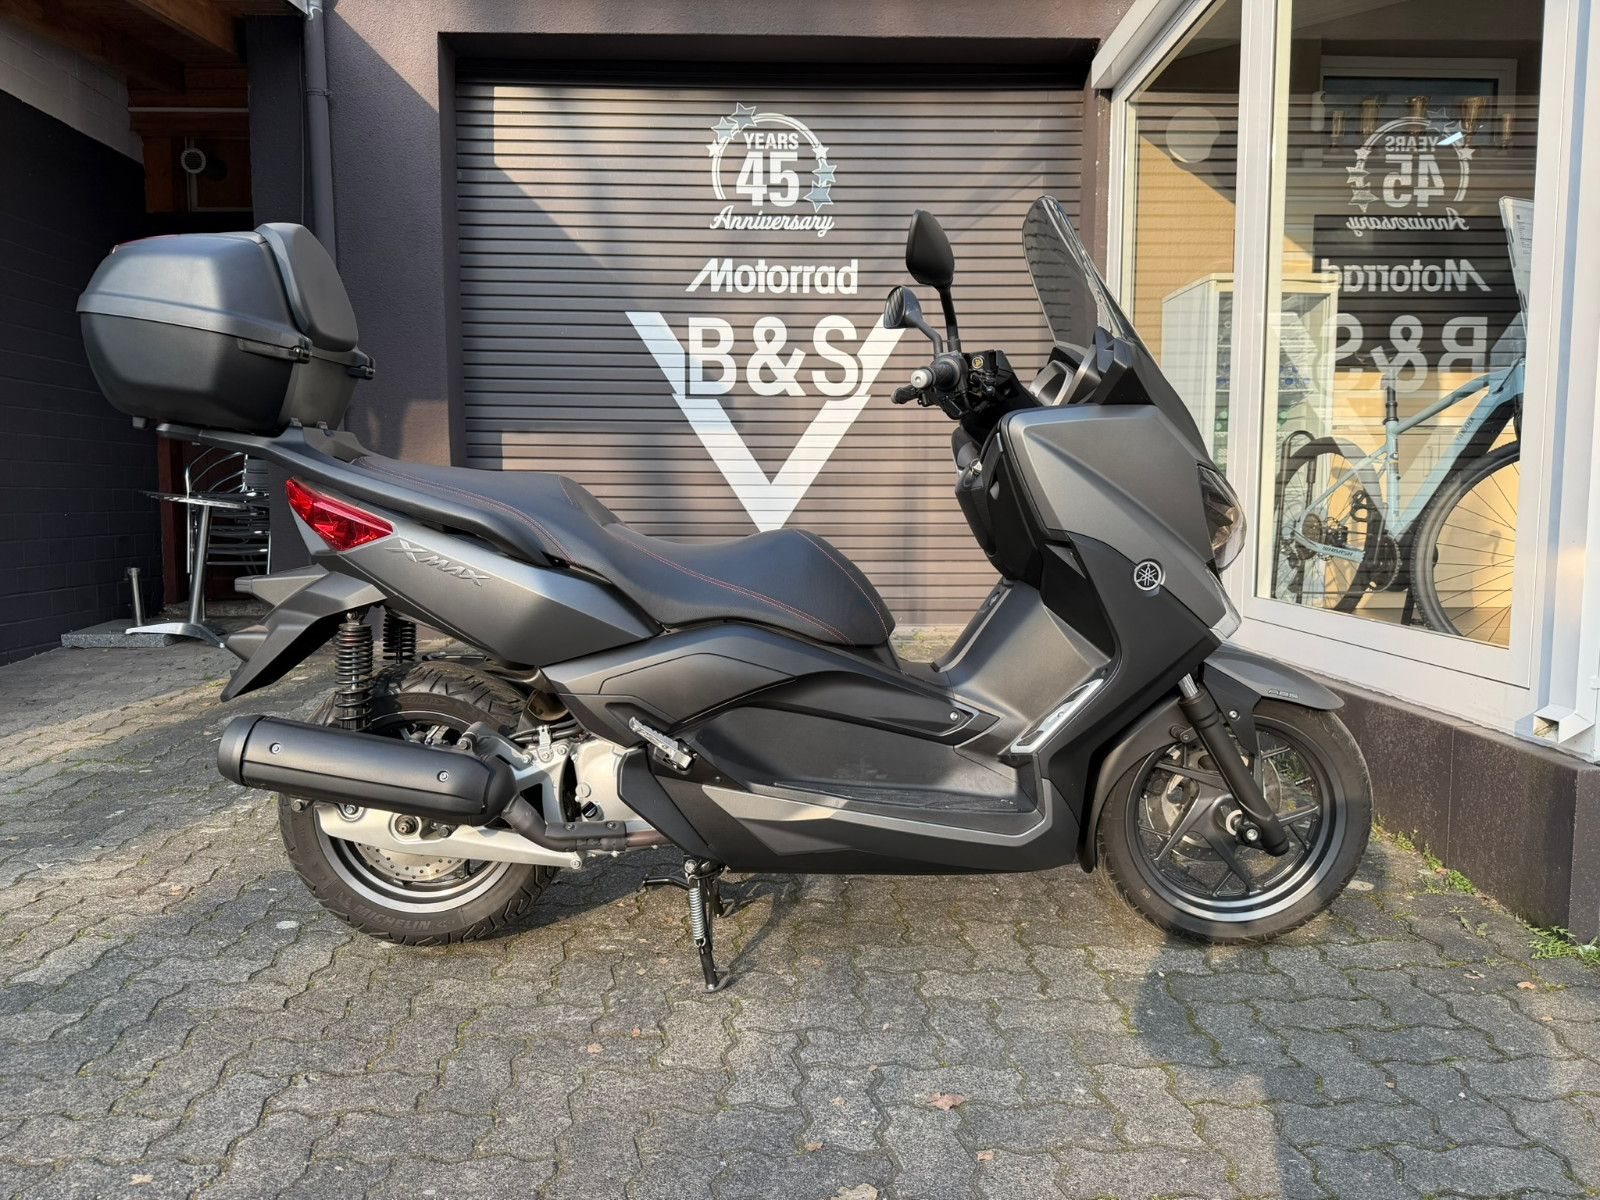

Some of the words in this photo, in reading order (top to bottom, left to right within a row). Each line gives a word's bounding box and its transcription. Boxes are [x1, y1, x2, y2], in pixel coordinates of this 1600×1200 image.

[743, 132, 799, 150] YEARS
[735, 151, 800, 207] 45
[709, 204, 835, 237] Anniversary
[685, 258, 858, 294] Motorrad
[688, 315, 859, 396] B&S
[353, 904, 432, 930] MICHELIN
